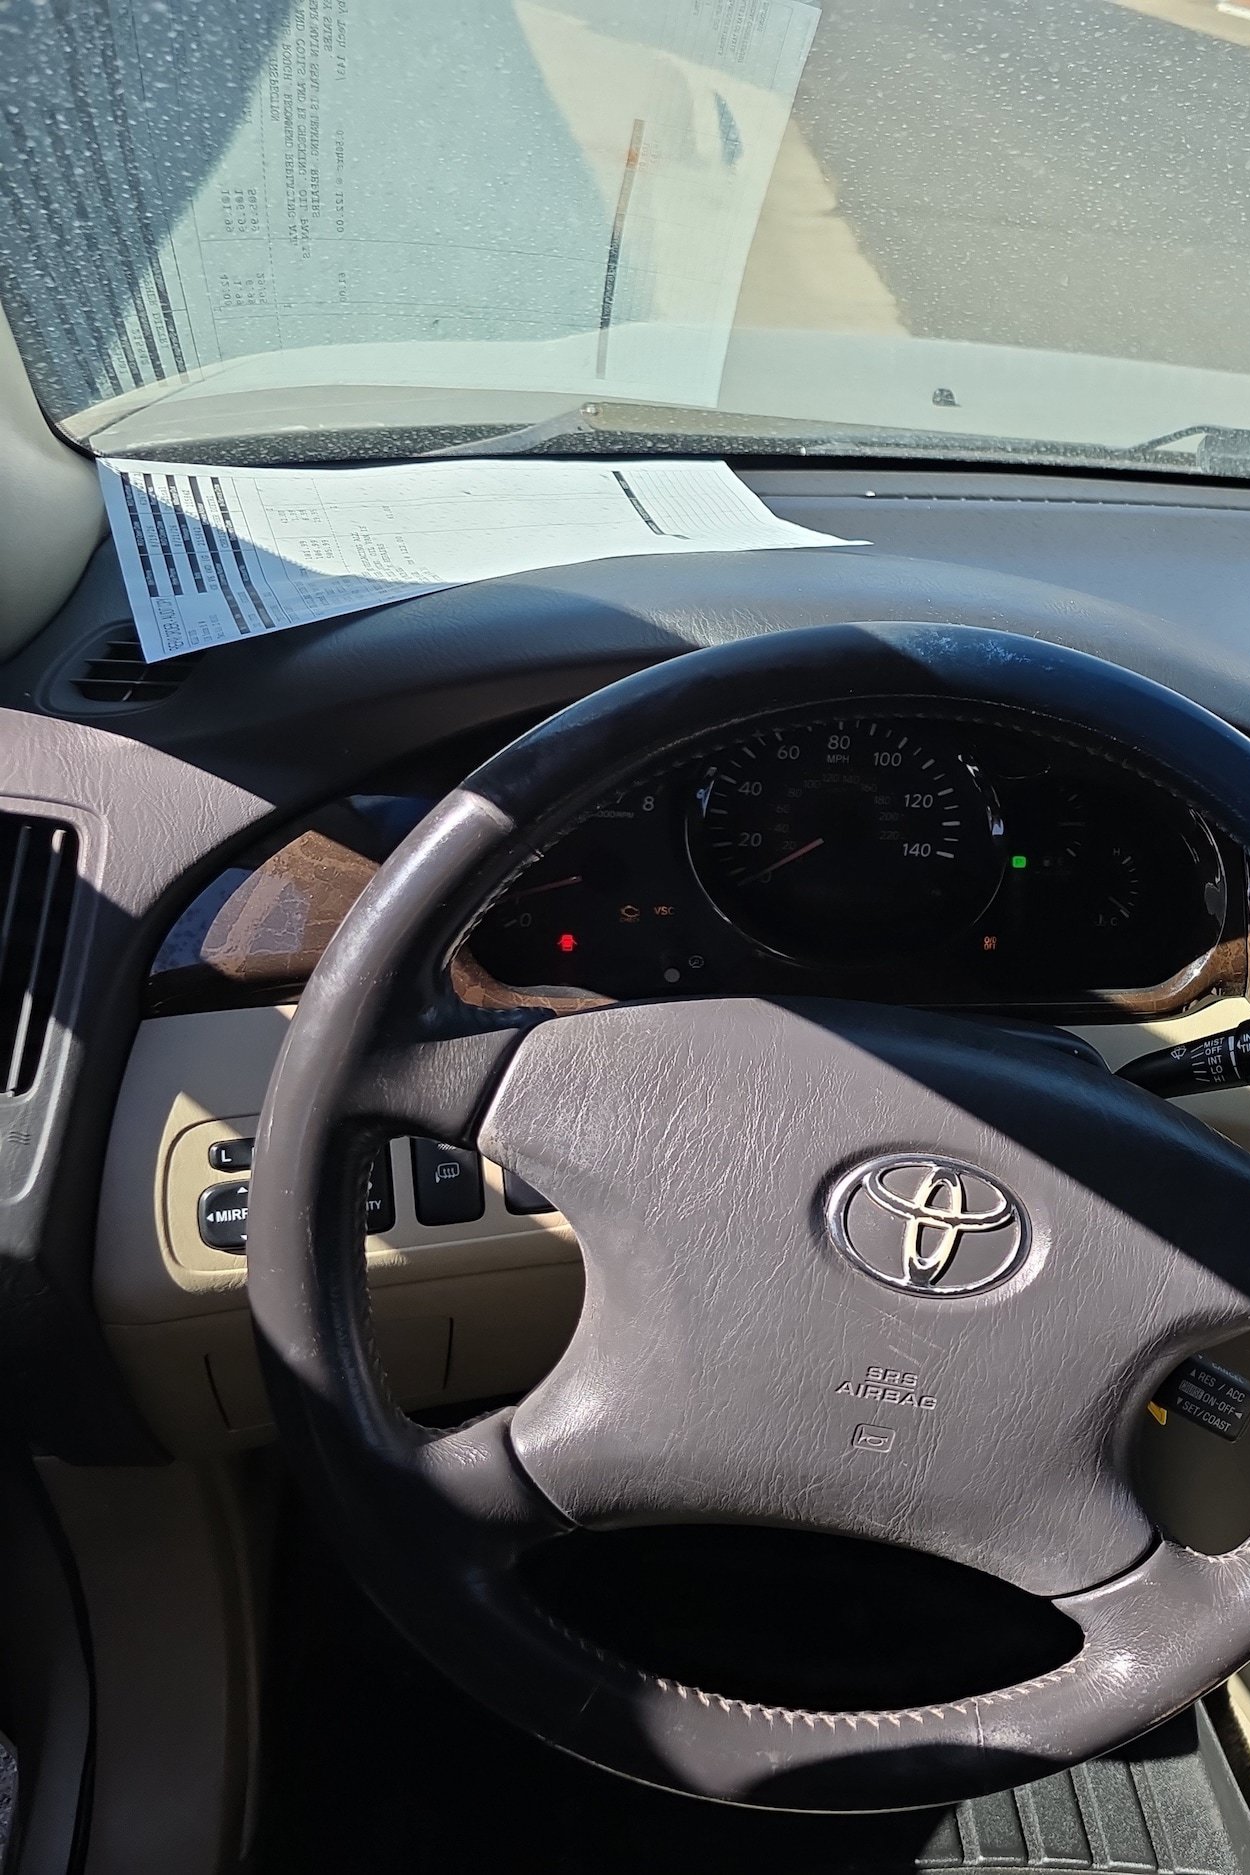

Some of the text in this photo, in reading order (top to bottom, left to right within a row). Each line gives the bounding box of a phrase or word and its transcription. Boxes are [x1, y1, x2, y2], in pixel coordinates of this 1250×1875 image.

[828, 735, 850, 750] 80
[777, 746, 800, 760] 60
[827, 754, 850, 764] MPH
[873, 752, 901, 767] 100
[737, 781, 762, 796] 40
[642, 796, 655, 811] 8
[904, 794, 933, 809] 120
[737, 832, 762, 847] 20
[902, 843, 931, 858] 140
[654, 906, 676, 916] VSC
[1204, 1036, 1224, 1047] MIST
[1204, 1045, 1223, 1056] OFF
[1208, 1055, 1222, 1066] INT
[1210, 1065, 1223, 1075] LO
[220, 1149, 232, 1164] L
[866, 1366, 919, 1388] SRS
[1198, 1372, 1216, 1388] RES
[1226, 1387, 1246, 1403] ACC
[835, 1380, 938, 1412] AIRBAG
[1202, 1392, 1236, 1416] ON-OFF
[1182, 1400, 1232, 1432] SET/COAST
